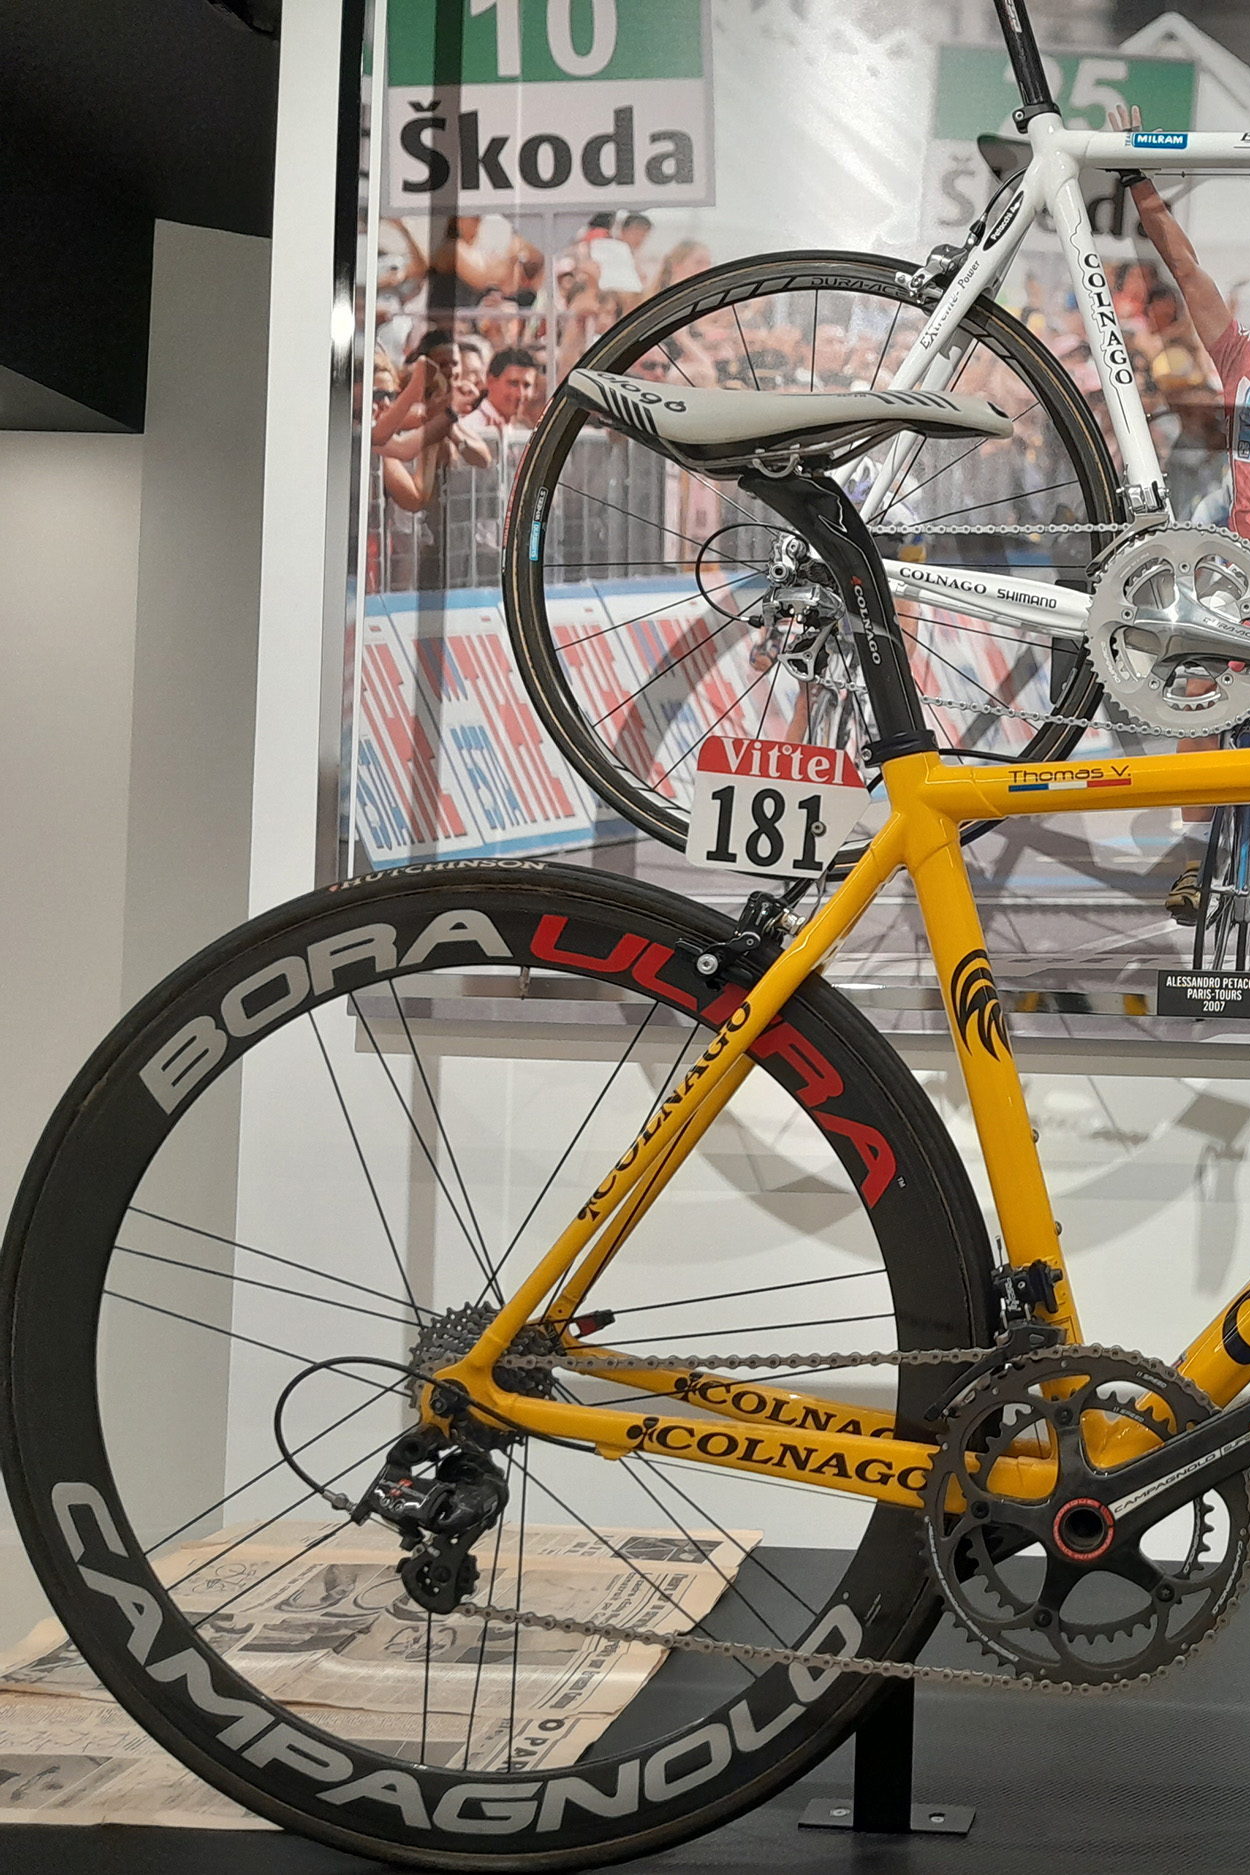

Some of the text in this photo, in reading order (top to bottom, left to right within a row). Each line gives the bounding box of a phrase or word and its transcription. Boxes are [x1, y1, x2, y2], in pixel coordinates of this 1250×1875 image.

[470, 0, 618, 78] 10
[400, 100, 695, 194] Škoda
[1137, 134, 1184, 145] MILRAM
[990, 212, 1013, 241] Petacchi
[957, 259, 981, 291] Power
[1084, 253, 1134, 385] COLNAGO
[899, 566, 1058, 610] COLNAGO SHIMANO
[854, 584, 882, 666] COLNAGO
[720, 737, 846, 785] Vittel
[1008, 765, 1131, 784] Thomas V.
[706, 785, 824, 872] 181
[339, 859, 548, 891] HUTCHINSON
[1166, 976, 1221, 988] ALESSANDRO
[1187, 988, 1243, 1001] PARIS-TOURS
[1203, 1001, 1226, 1012] 2007
[139, 909, 513, 1115] BORA
[592, 1000, 754, 1199] COLNAGO
[655, 1424, 930, 1492] COLNAGO
[1113, 1452, 1217, 1515] CAMPAGNOLO
[51, 1481, 863, 1835] CAMPAGNOLO
